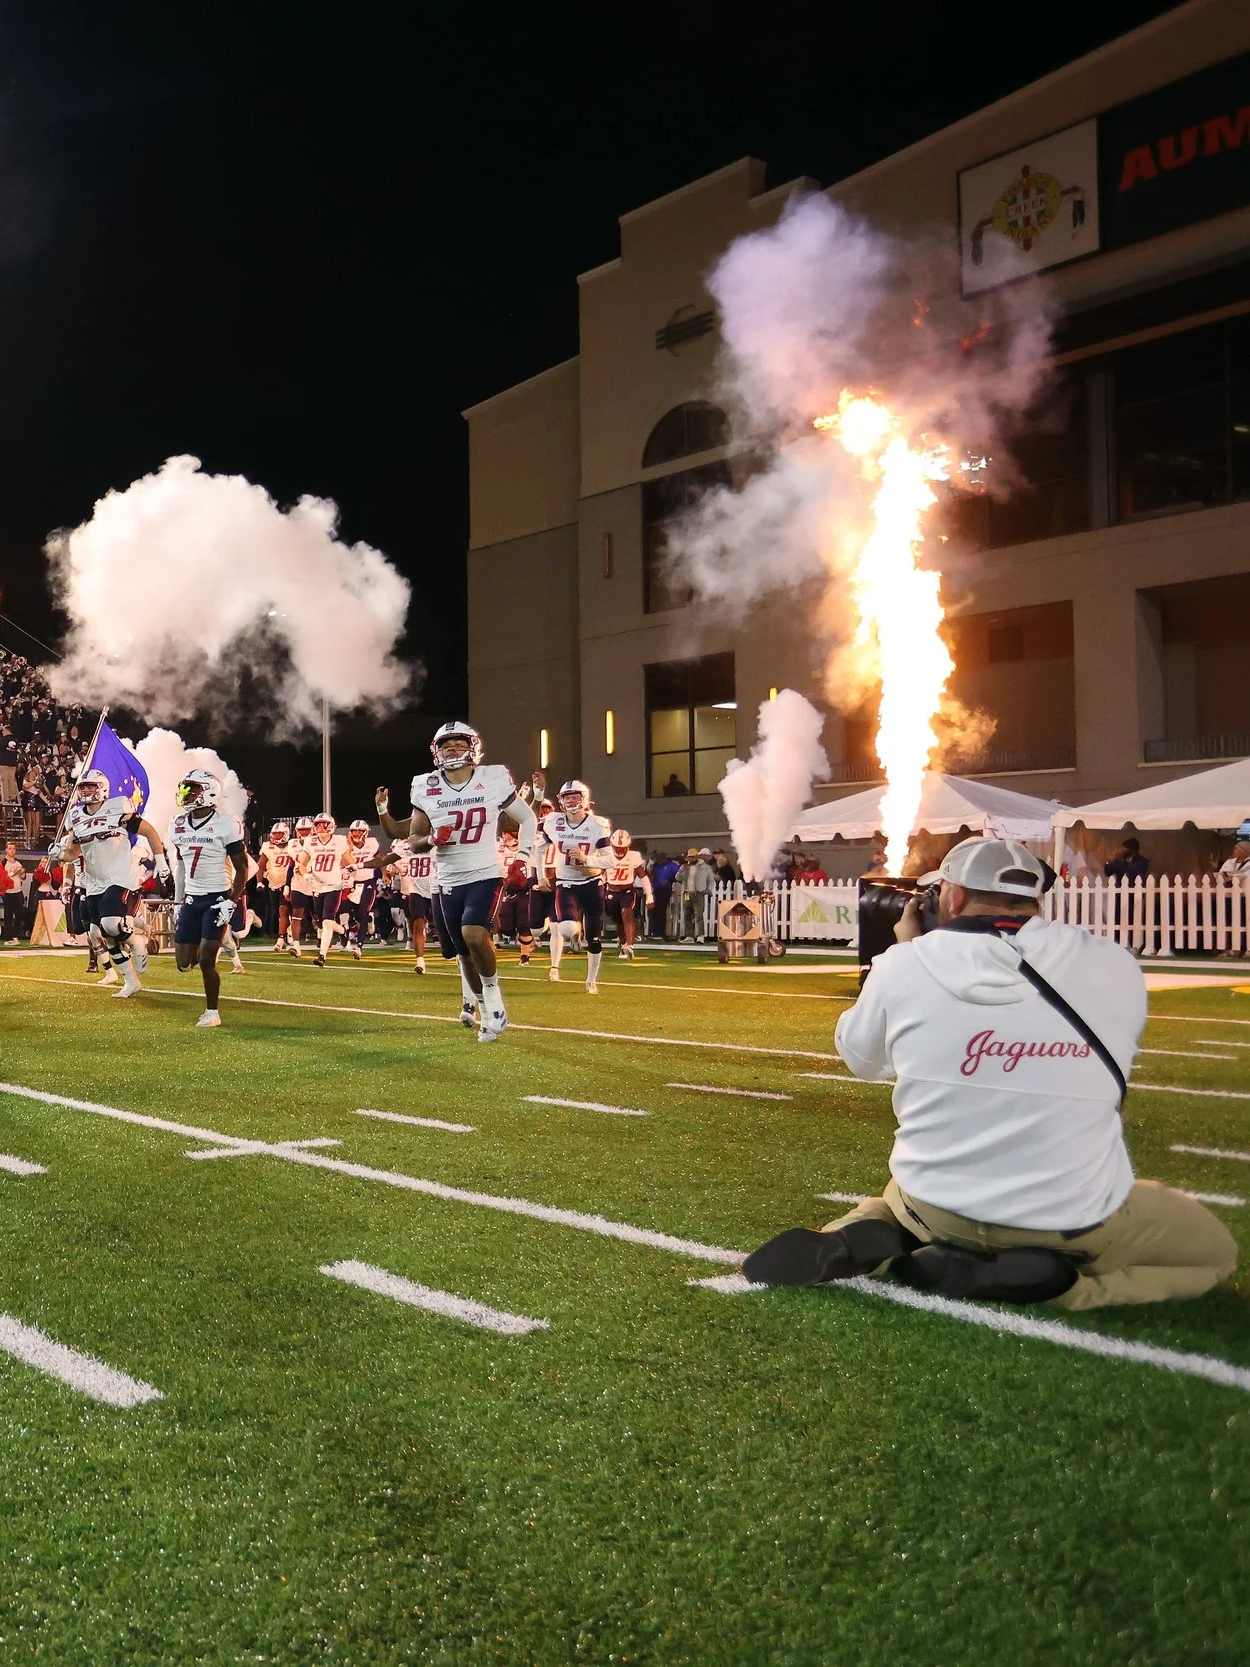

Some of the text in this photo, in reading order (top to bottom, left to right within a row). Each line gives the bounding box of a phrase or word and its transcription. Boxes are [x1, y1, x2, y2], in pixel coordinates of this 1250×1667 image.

[444, 806, 487, 846] 28
[188, 846, 204, 879] 7
[314, 853, 336, 872] 80
[409, 857, 431, 878] 88
[959, 1029, 1091, 1077] Jaguars
